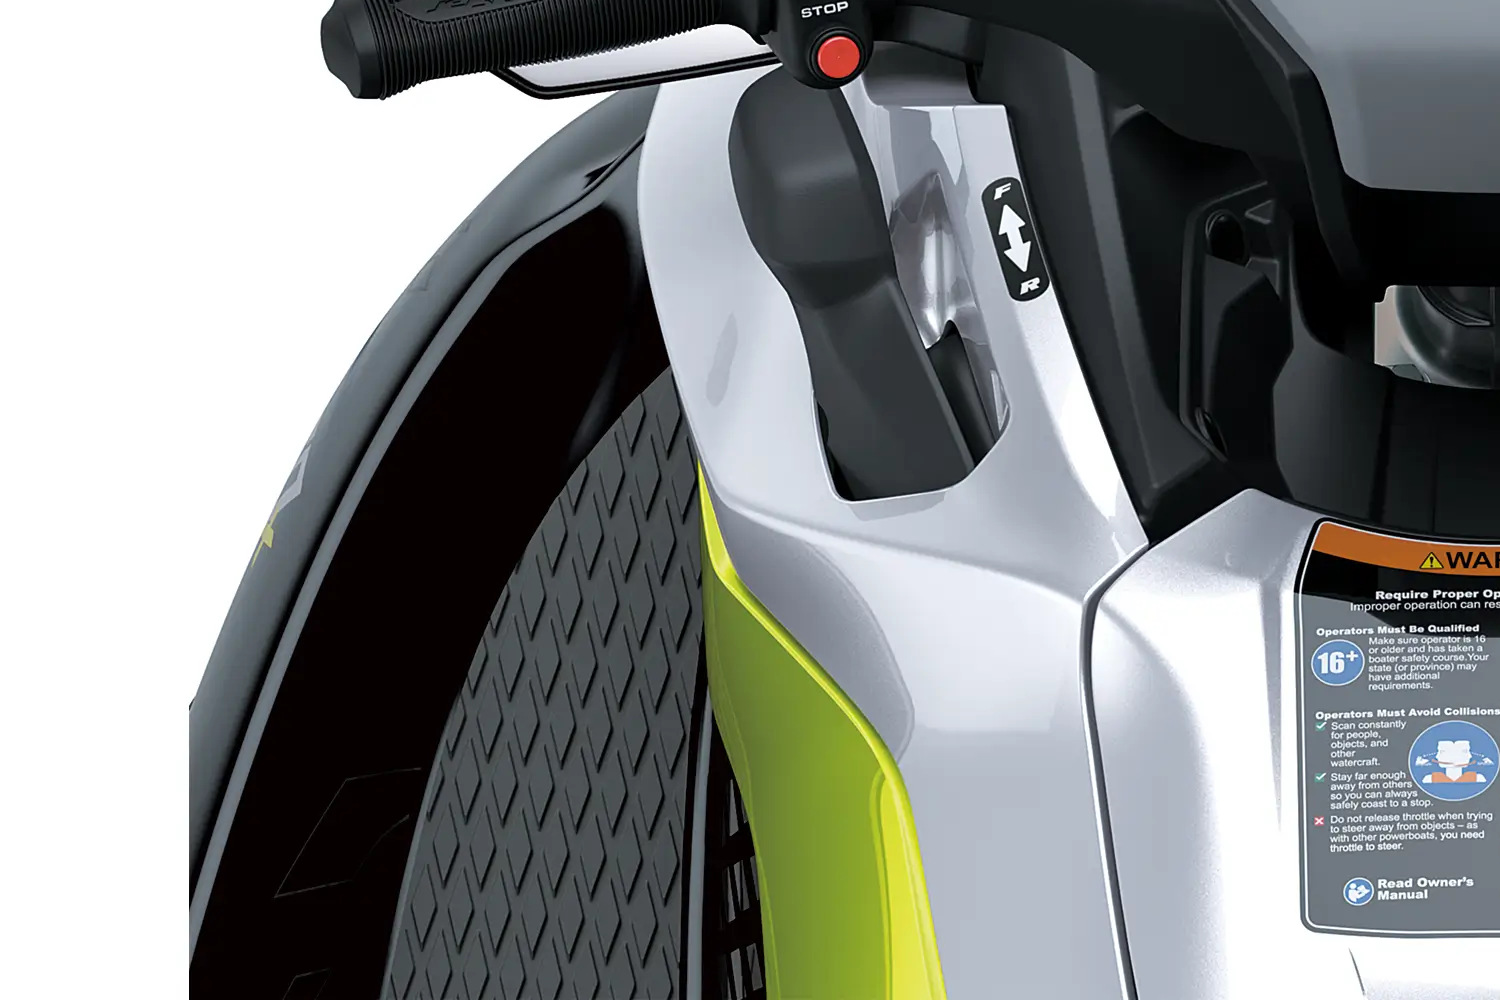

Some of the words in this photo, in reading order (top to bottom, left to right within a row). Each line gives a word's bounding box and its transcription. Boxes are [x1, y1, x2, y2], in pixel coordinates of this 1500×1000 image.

[801, 1, 848, 18] STOP
[994, 182, 1012, 200] F
[1020, 277, 1040, 295] R
[1375, 589, 1429, 601] Require
[1433, 588, 1479, 601] Proper
[1351, 601, 1401, 614] Improper
[1404, 600, 1457, 612] operation
[1317, 626, 1374, 638] Operators
[1378, 626, 1405, 634] Must
[1409, 625, 1425, 634] Be
[1428, 624, 1480, 633] Qualified
[1369, 637, 1395, 645] Make
[1420, 636, 1461, 646] operator
[1463, 635, 1472, 643] is
[1475, 635, 1486, 643] 16
[1380, 645, 1405, 654] older
[1407, 645, 1426, 653] and
[1428, 644, 1446, 653] has
[1448, 644, 1474, 652] taken
[1317, 650, 1358, 674] 16+
[1368, 655, 1399, 663] boater
[1401, 654, 1430, 664] safety
[1368, 664, 1392, 672] state
[1394, 663, 1408, 674] (or
[1410, 663, 1455, 673] province)
[1457, 664, 1477, 672] may
[1368, 673, 1392, 681] have
[1394, 671, 1440, 680] additional
[1368, 680, 1433, 692] requirements.
[1315, 710, 1373, 721] Operators
[1377, 709, 1405, 718] Must
[1409, 708, 1441, 717] Avoid
[1444, 707, 1500, 716] Collisions
[1331, 721, 1356, 730] Scan
[1358, 720, 1407, 731] constantly
[1331, 731, 1344, 739] for
[1346, 730, 1381, 741] people,
[1331, 739, 1367, 750] objects,
[1370, 739, 1389, 747] and
[1330, 749, 1356, 757] other
[1330, 758, 1381, 767] watercraft.
[1330, 772, 1353, 783] Stay
[1355, 772, 1368, 780] far
[1370, 771, 1406, 782] enough
[1330, 783, 1356, 792] away
[1358, 781, 1380, 790] from
[1382, 780, 1413, 789] others
[1345, 793, 1363, 801] you
[1385, 789, 1418, 800] always
[1330, 800, 1359, 811] safely
[1361, 800, 1387, 808] coast
[1389, 799, 1399, 807] to
[1410, 798, 1434, 809] stop.
[1330, 815, 1345, 823] Do
[1347, 814, 1362, 823] not
[1364, 814, 1400, 822] release
[1403, 813, 1436, 822] throttle
[1438, 812, 1464, 821] when
[1466, 812, 1493, 822] trying
[1330, 824, 1340, 832] to
[1342, 824, 1366, 832] steer
[1369, 824, 1394, 833] away
[1396, 822, 1419, 831] from
[1420, 821, 1455, 832] objects
[1330, 834, 1350, 842] with
[1352, 833, 1377, 842] other
[1379, 832, 1438, 843] powerboats,
[1440, 833, 1458, 841] you
[1460, 830, 1485, 839] need
[1330, 843, 1363, 852] throttle
[1365, 842, 1375, 851] to
[1378, 842, 1404, 850] steer.
[1378, 878, 1413, 888] Read
[1417, 876, 1474, 888] Owner's
[1377, 889, 1428, 900] Manual
